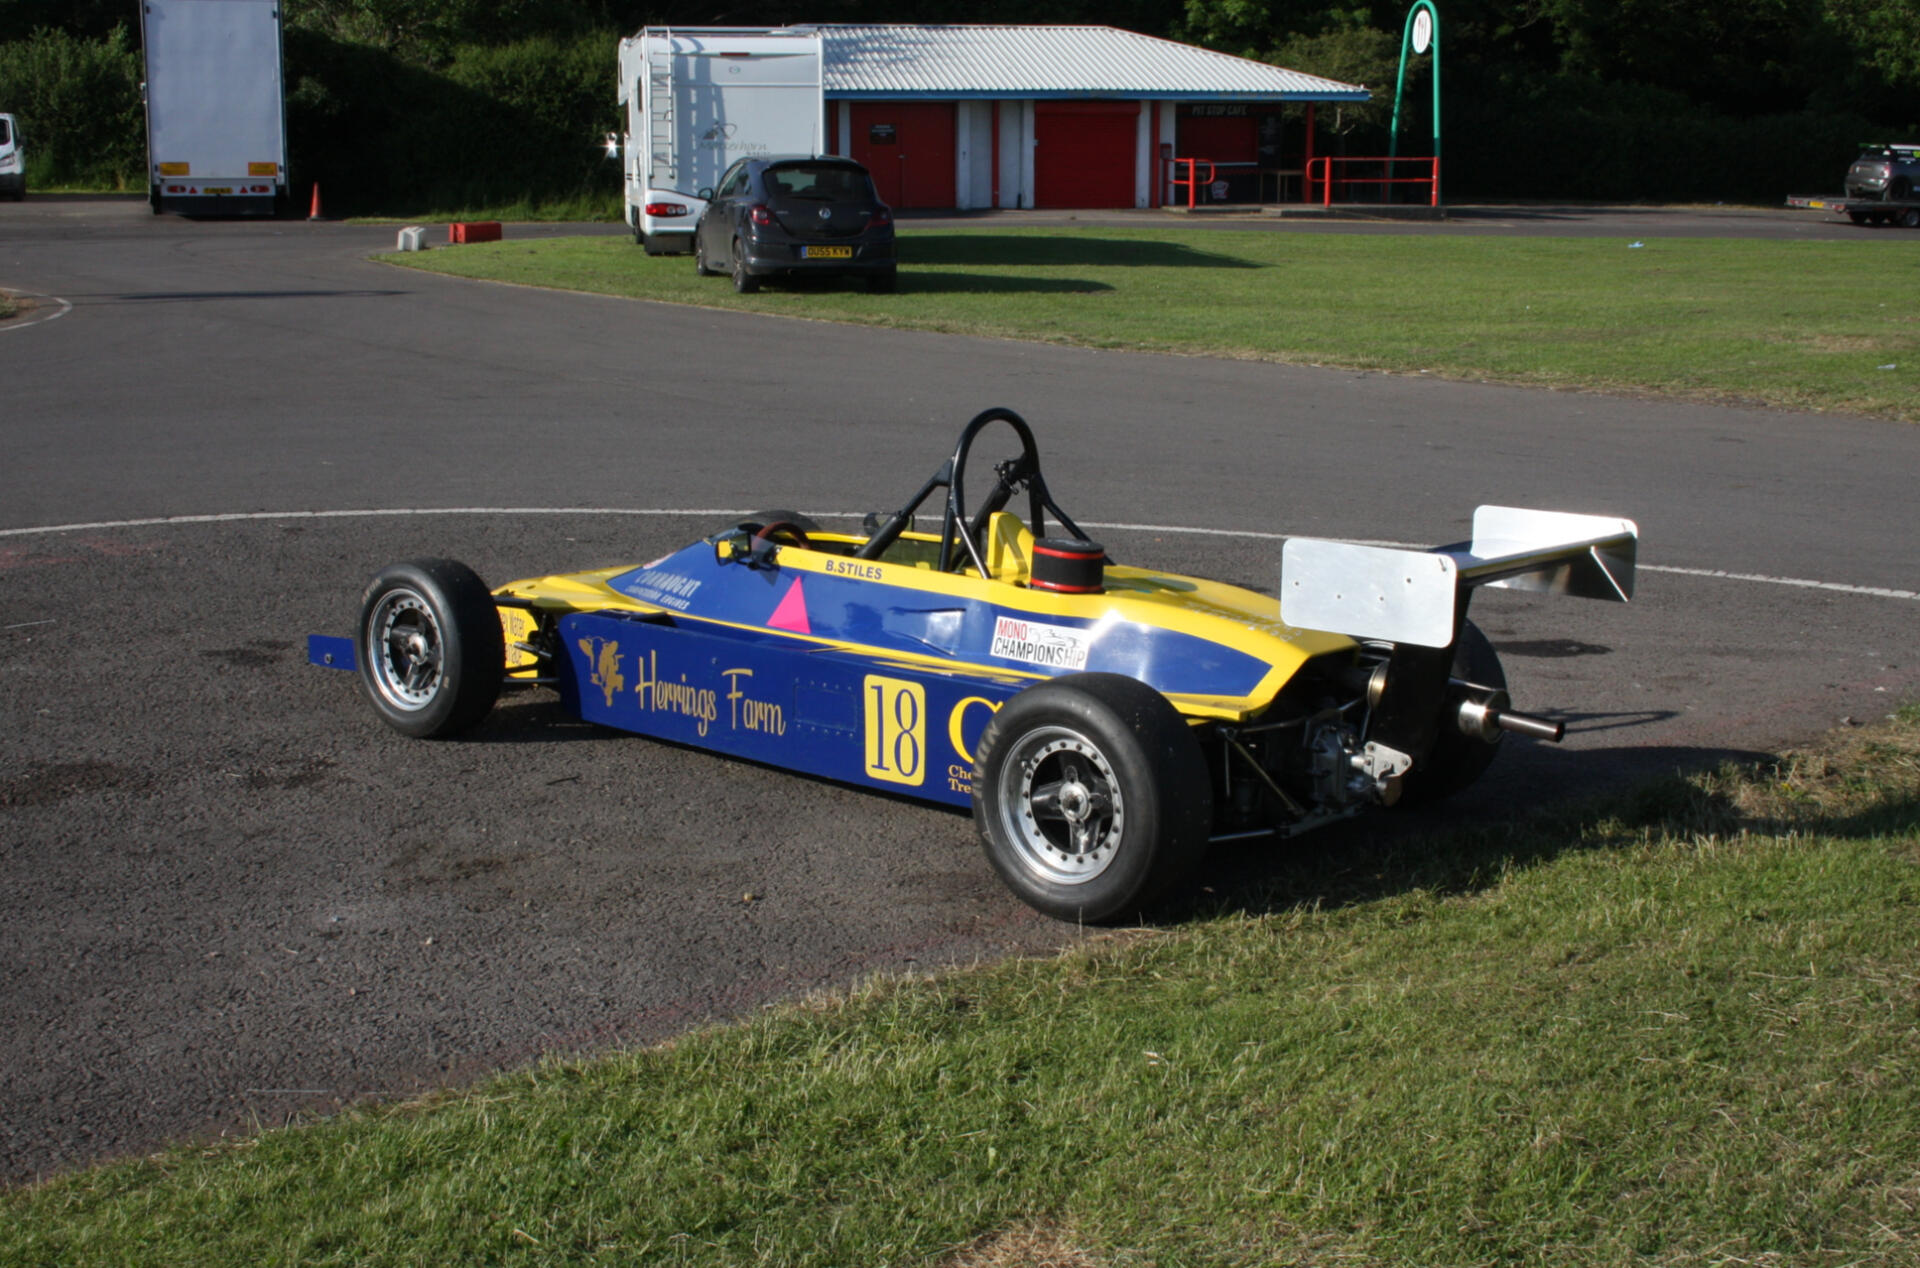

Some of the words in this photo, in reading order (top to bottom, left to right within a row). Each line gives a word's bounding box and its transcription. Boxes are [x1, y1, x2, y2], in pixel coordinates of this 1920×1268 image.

[825, 560, 883, 580] B.STILES
[997, 619, 1028, 641] MONO
[993, 637, 1086, 667] CHAMPIONSHIP
[635, 649, 717, 736] Herrings
[721, 668, 786, 736] Farm
[870, 685, 919, 777] 18
